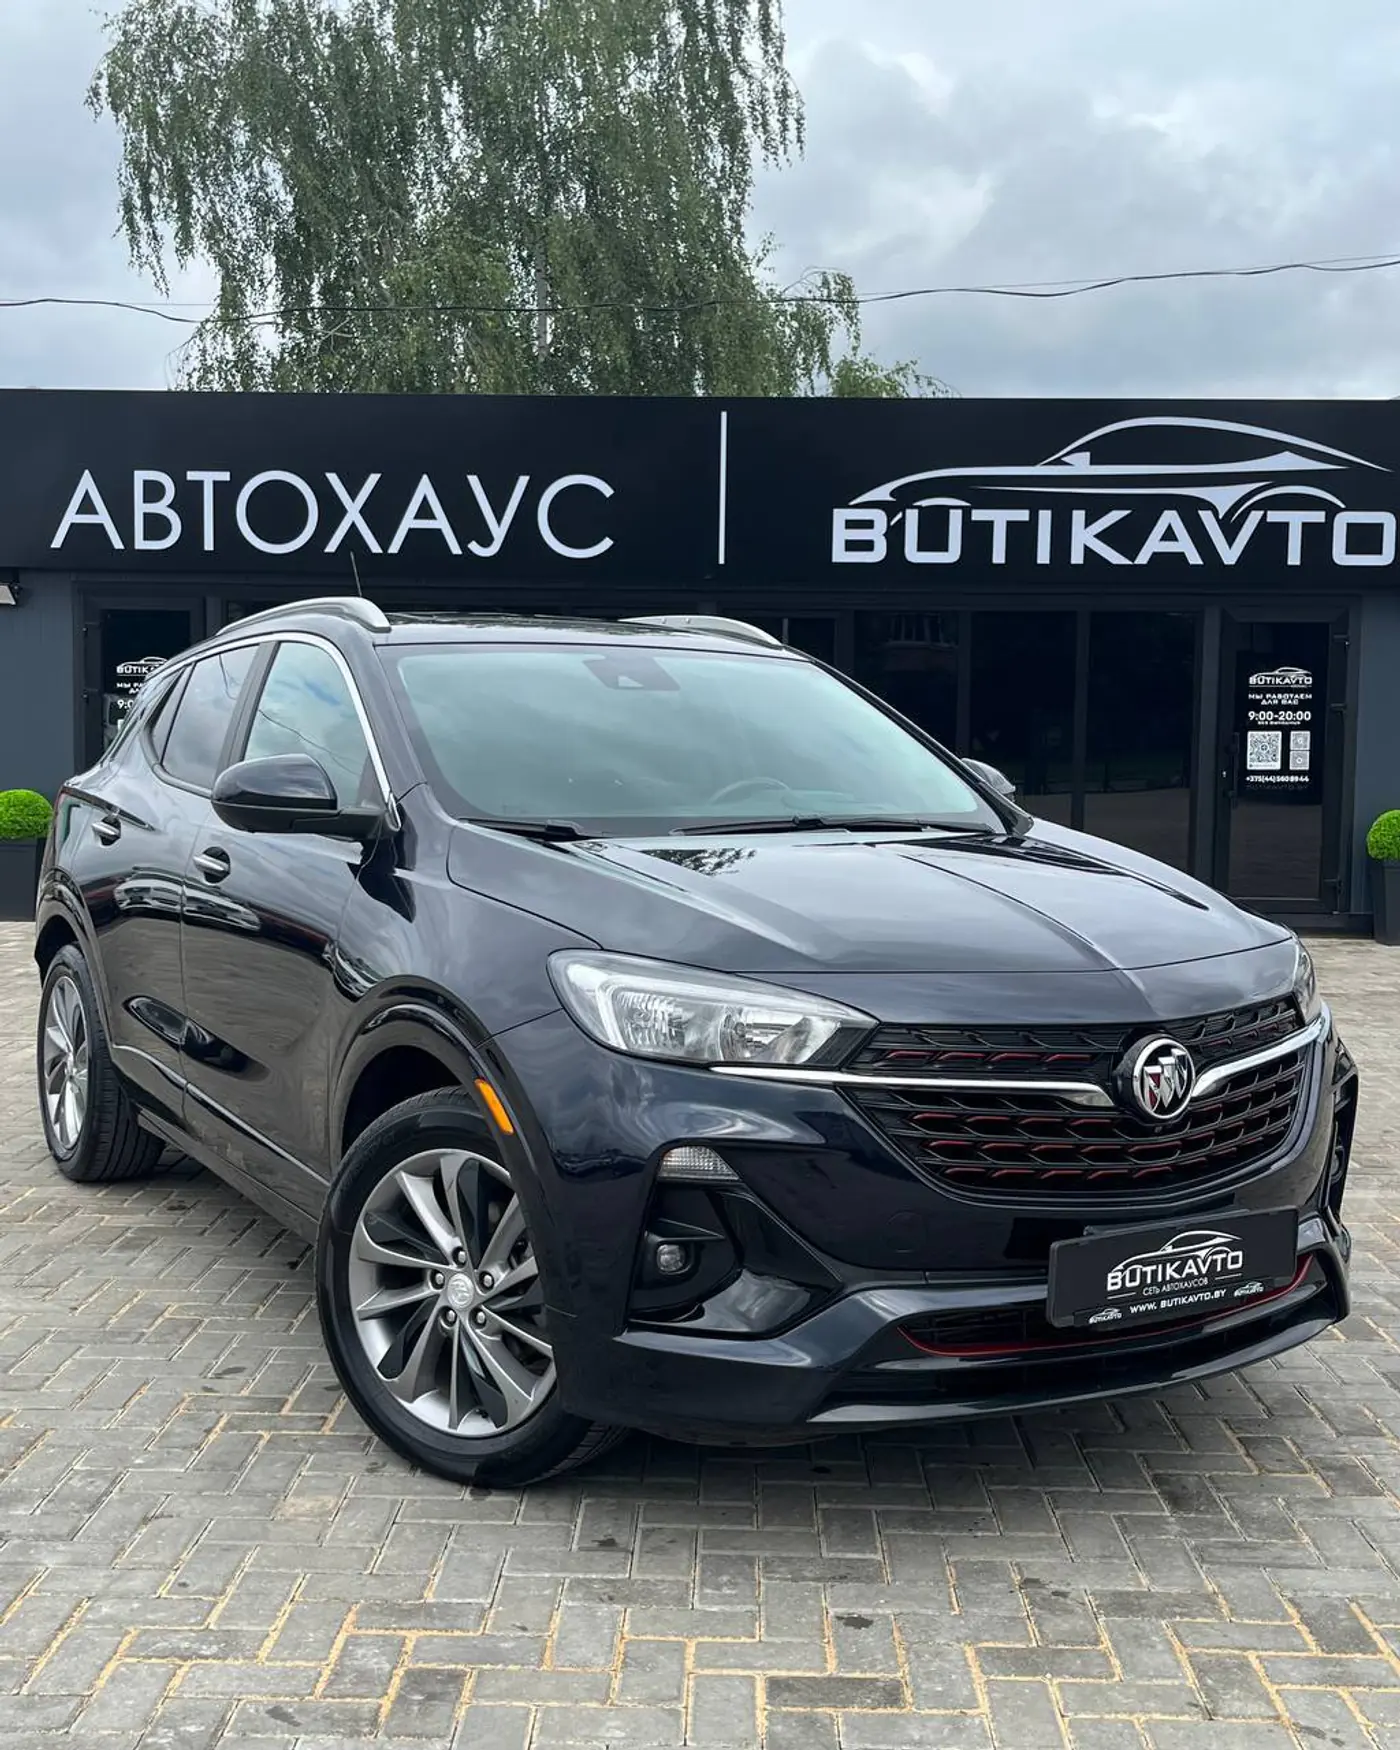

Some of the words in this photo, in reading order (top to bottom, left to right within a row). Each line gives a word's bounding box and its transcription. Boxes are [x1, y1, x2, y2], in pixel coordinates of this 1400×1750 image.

[49, 468, 615, 559] АВТОХАУС
[831, 507, 1397, 567] BUTIKAVTO
[1248, 675, 1313, 685] BUTIKAVTO
[1248, 711, 1312, 721] 9:00-20:00
[1106, 1249, 1243, 1291] BUTIKAVTO
[1142, 1284, 1160, 1296] СЕТЬ
[1161, 1276, 1209, 1293] АВТОХАУСОВ
[1130, 1301, 1157, 1314] WWW.
[1160, 1288, 1227, 1309] BUTIKAVTO.BY
